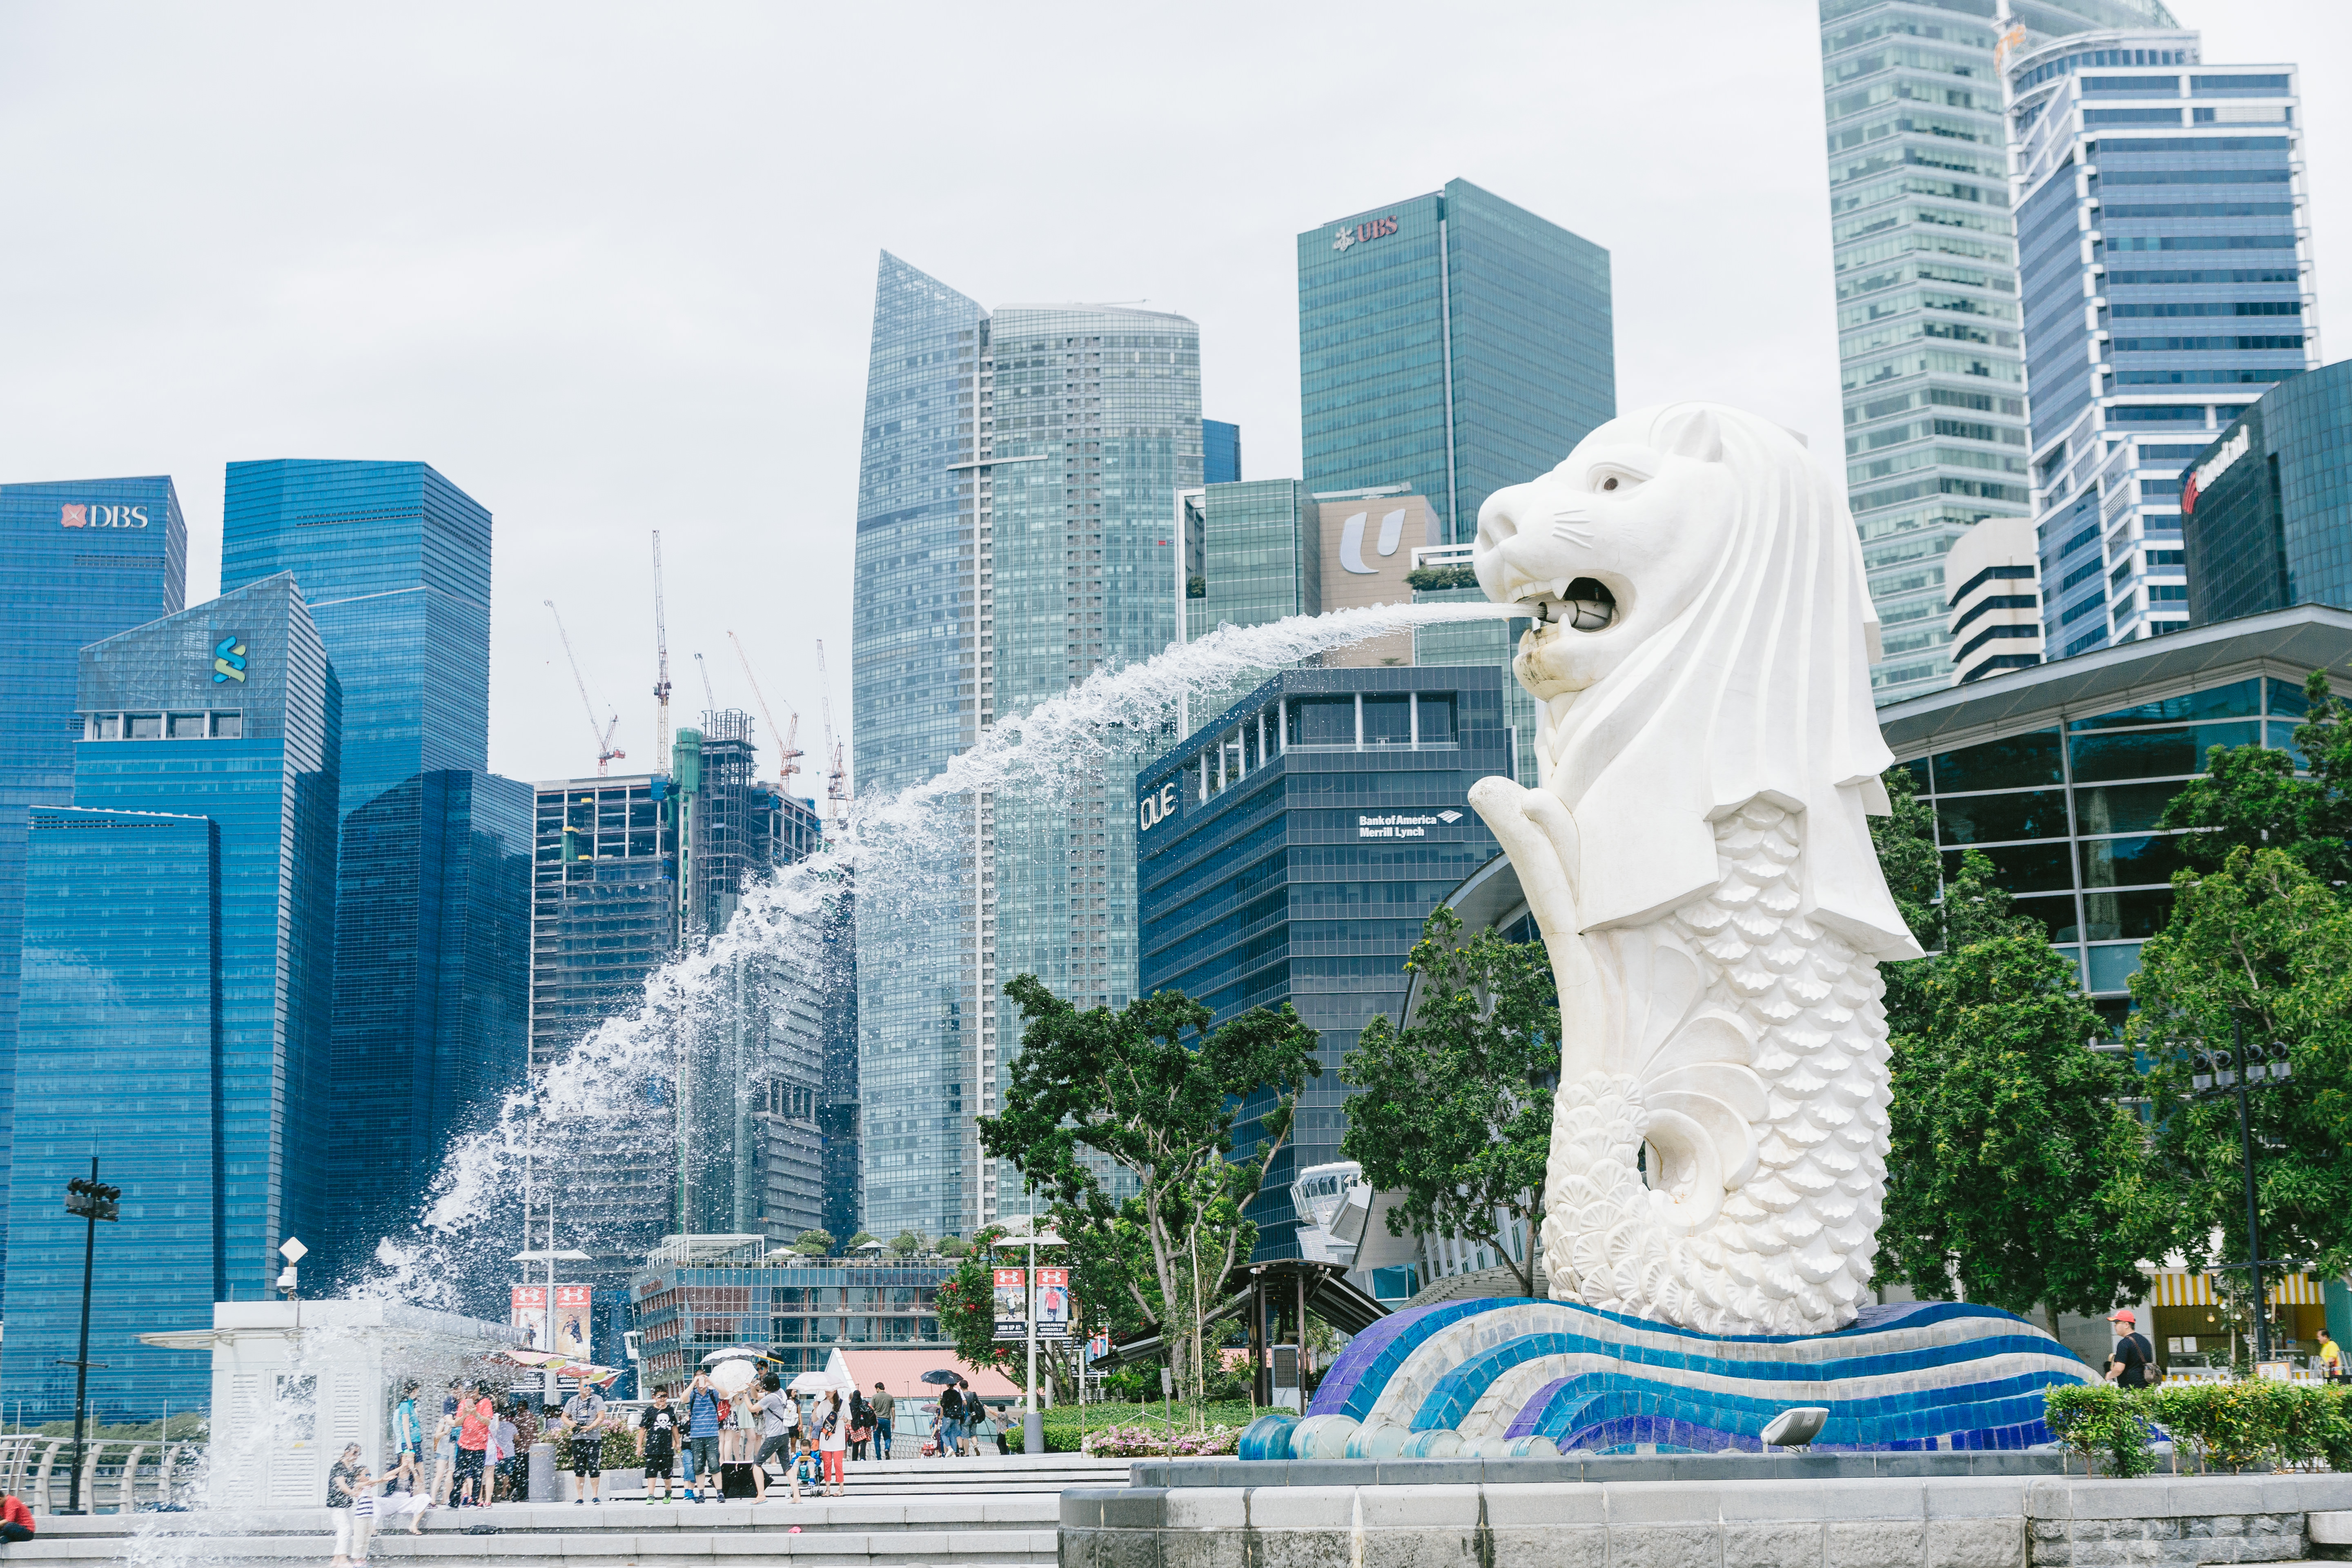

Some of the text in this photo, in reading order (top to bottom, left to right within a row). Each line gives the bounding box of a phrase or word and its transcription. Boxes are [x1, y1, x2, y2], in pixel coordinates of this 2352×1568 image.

[1357, 215, 1398, 243] UBS
[90, 505, 149, 528] DBS
[1140, 782, 1176, 831] OUE
[1359, 815, 1437, 826] Bank of America
[1360, 826, 1424, 838] Merrill Lynch
[846, 1271, 942, 1284] THE FULLERTON
